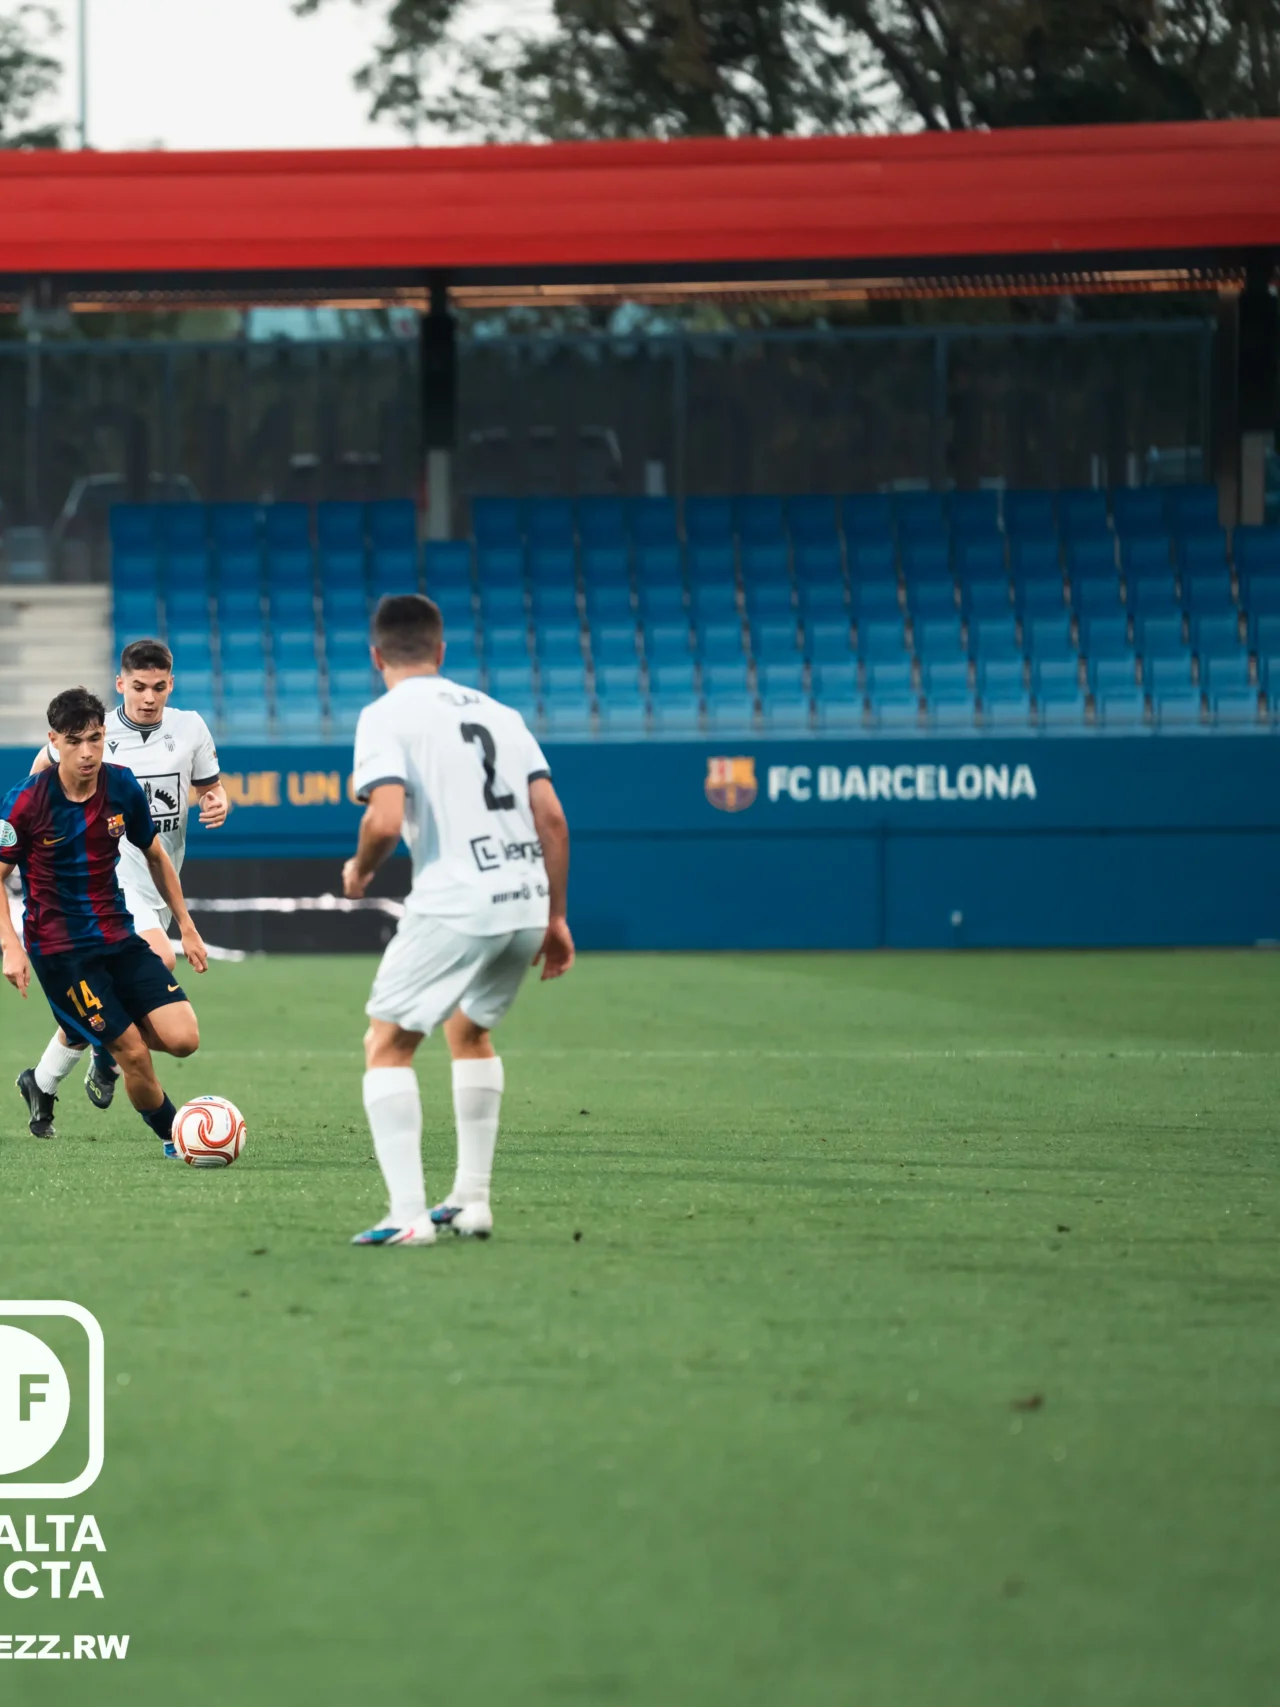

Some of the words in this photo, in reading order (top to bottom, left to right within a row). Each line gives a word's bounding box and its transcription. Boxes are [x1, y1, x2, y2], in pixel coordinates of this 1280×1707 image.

[460, 722, 516, 811] 2
[768, 766, 811, 800] FC
[818, 764, 1037, 800] BARCELONA
[287, 771, 341, 806] UN
[66, 979, 104, 1018] 14
